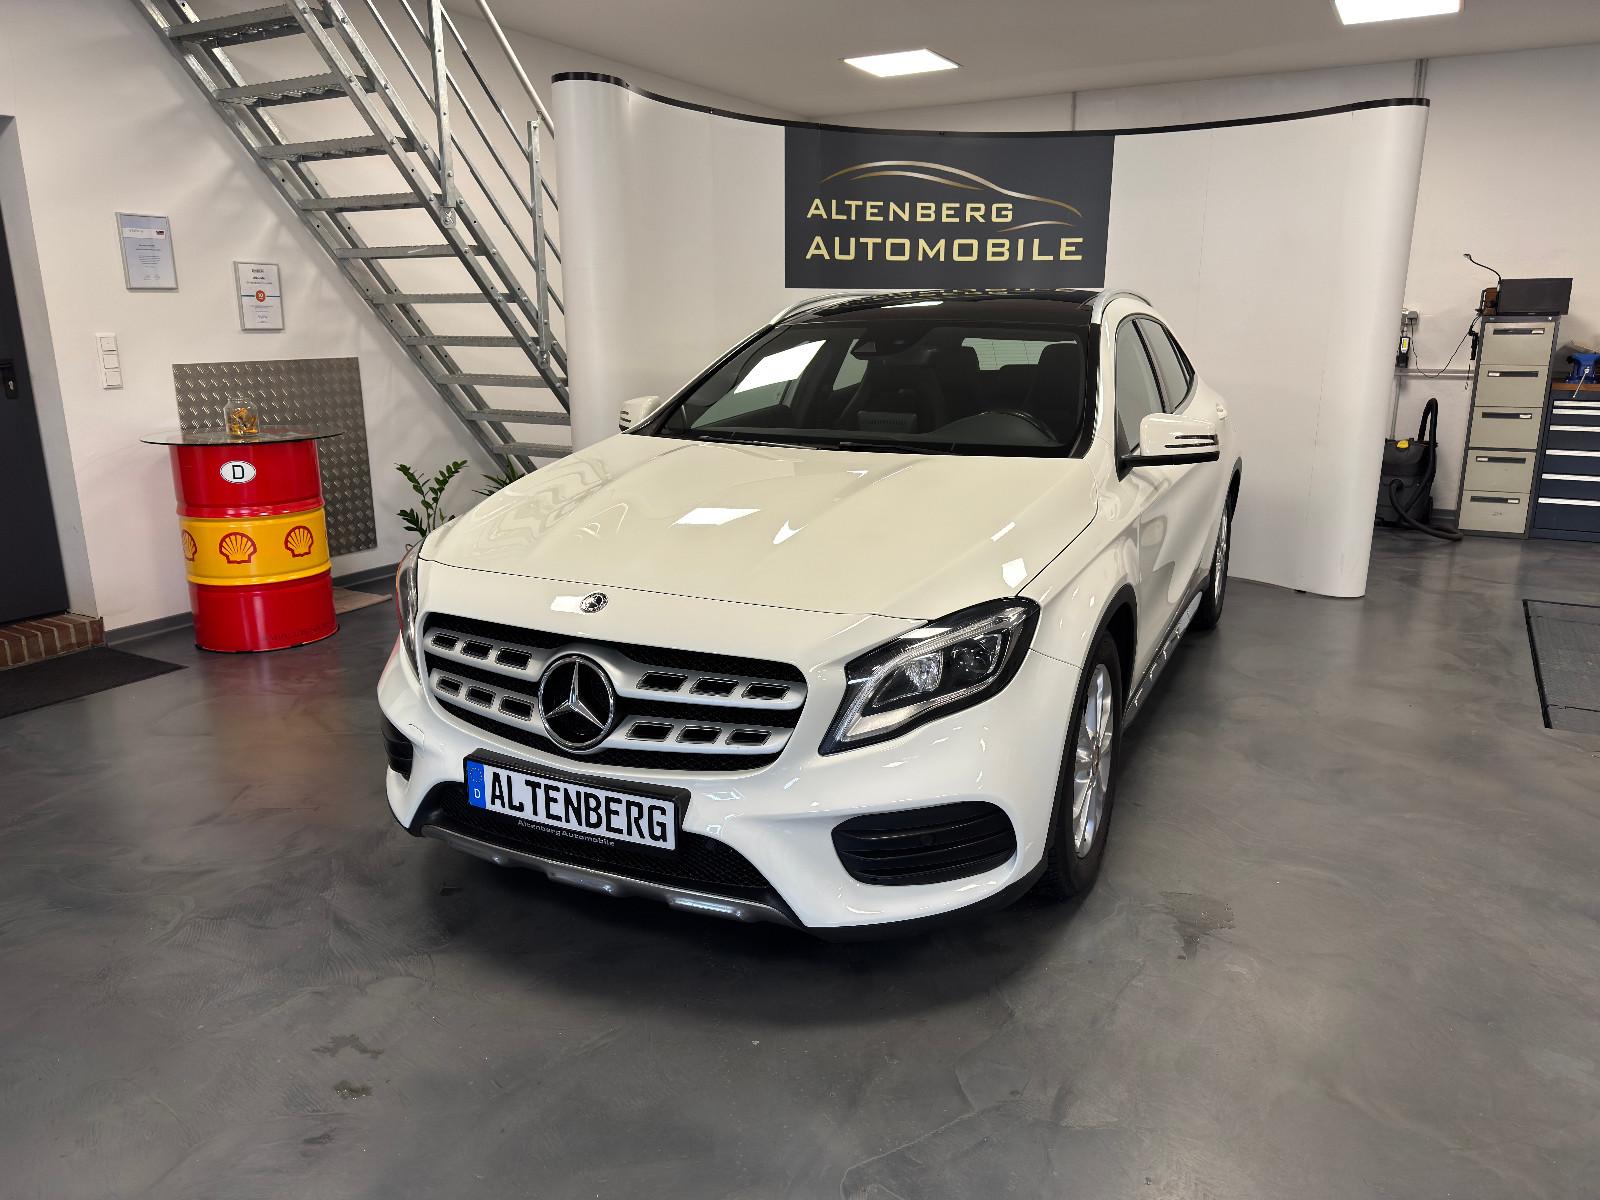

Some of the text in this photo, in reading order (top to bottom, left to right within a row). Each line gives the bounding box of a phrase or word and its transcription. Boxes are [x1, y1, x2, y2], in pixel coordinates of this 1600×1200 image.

[806, 198, 1014, 223] ALTENBERG
[805, 236, 1084, 262] AUTOMOBILE
[232, 465, 244, 479] D
[474, 771, 668, 843] D ALTENBERG
[517, 819, 615, 847] Altenberg Automobile
